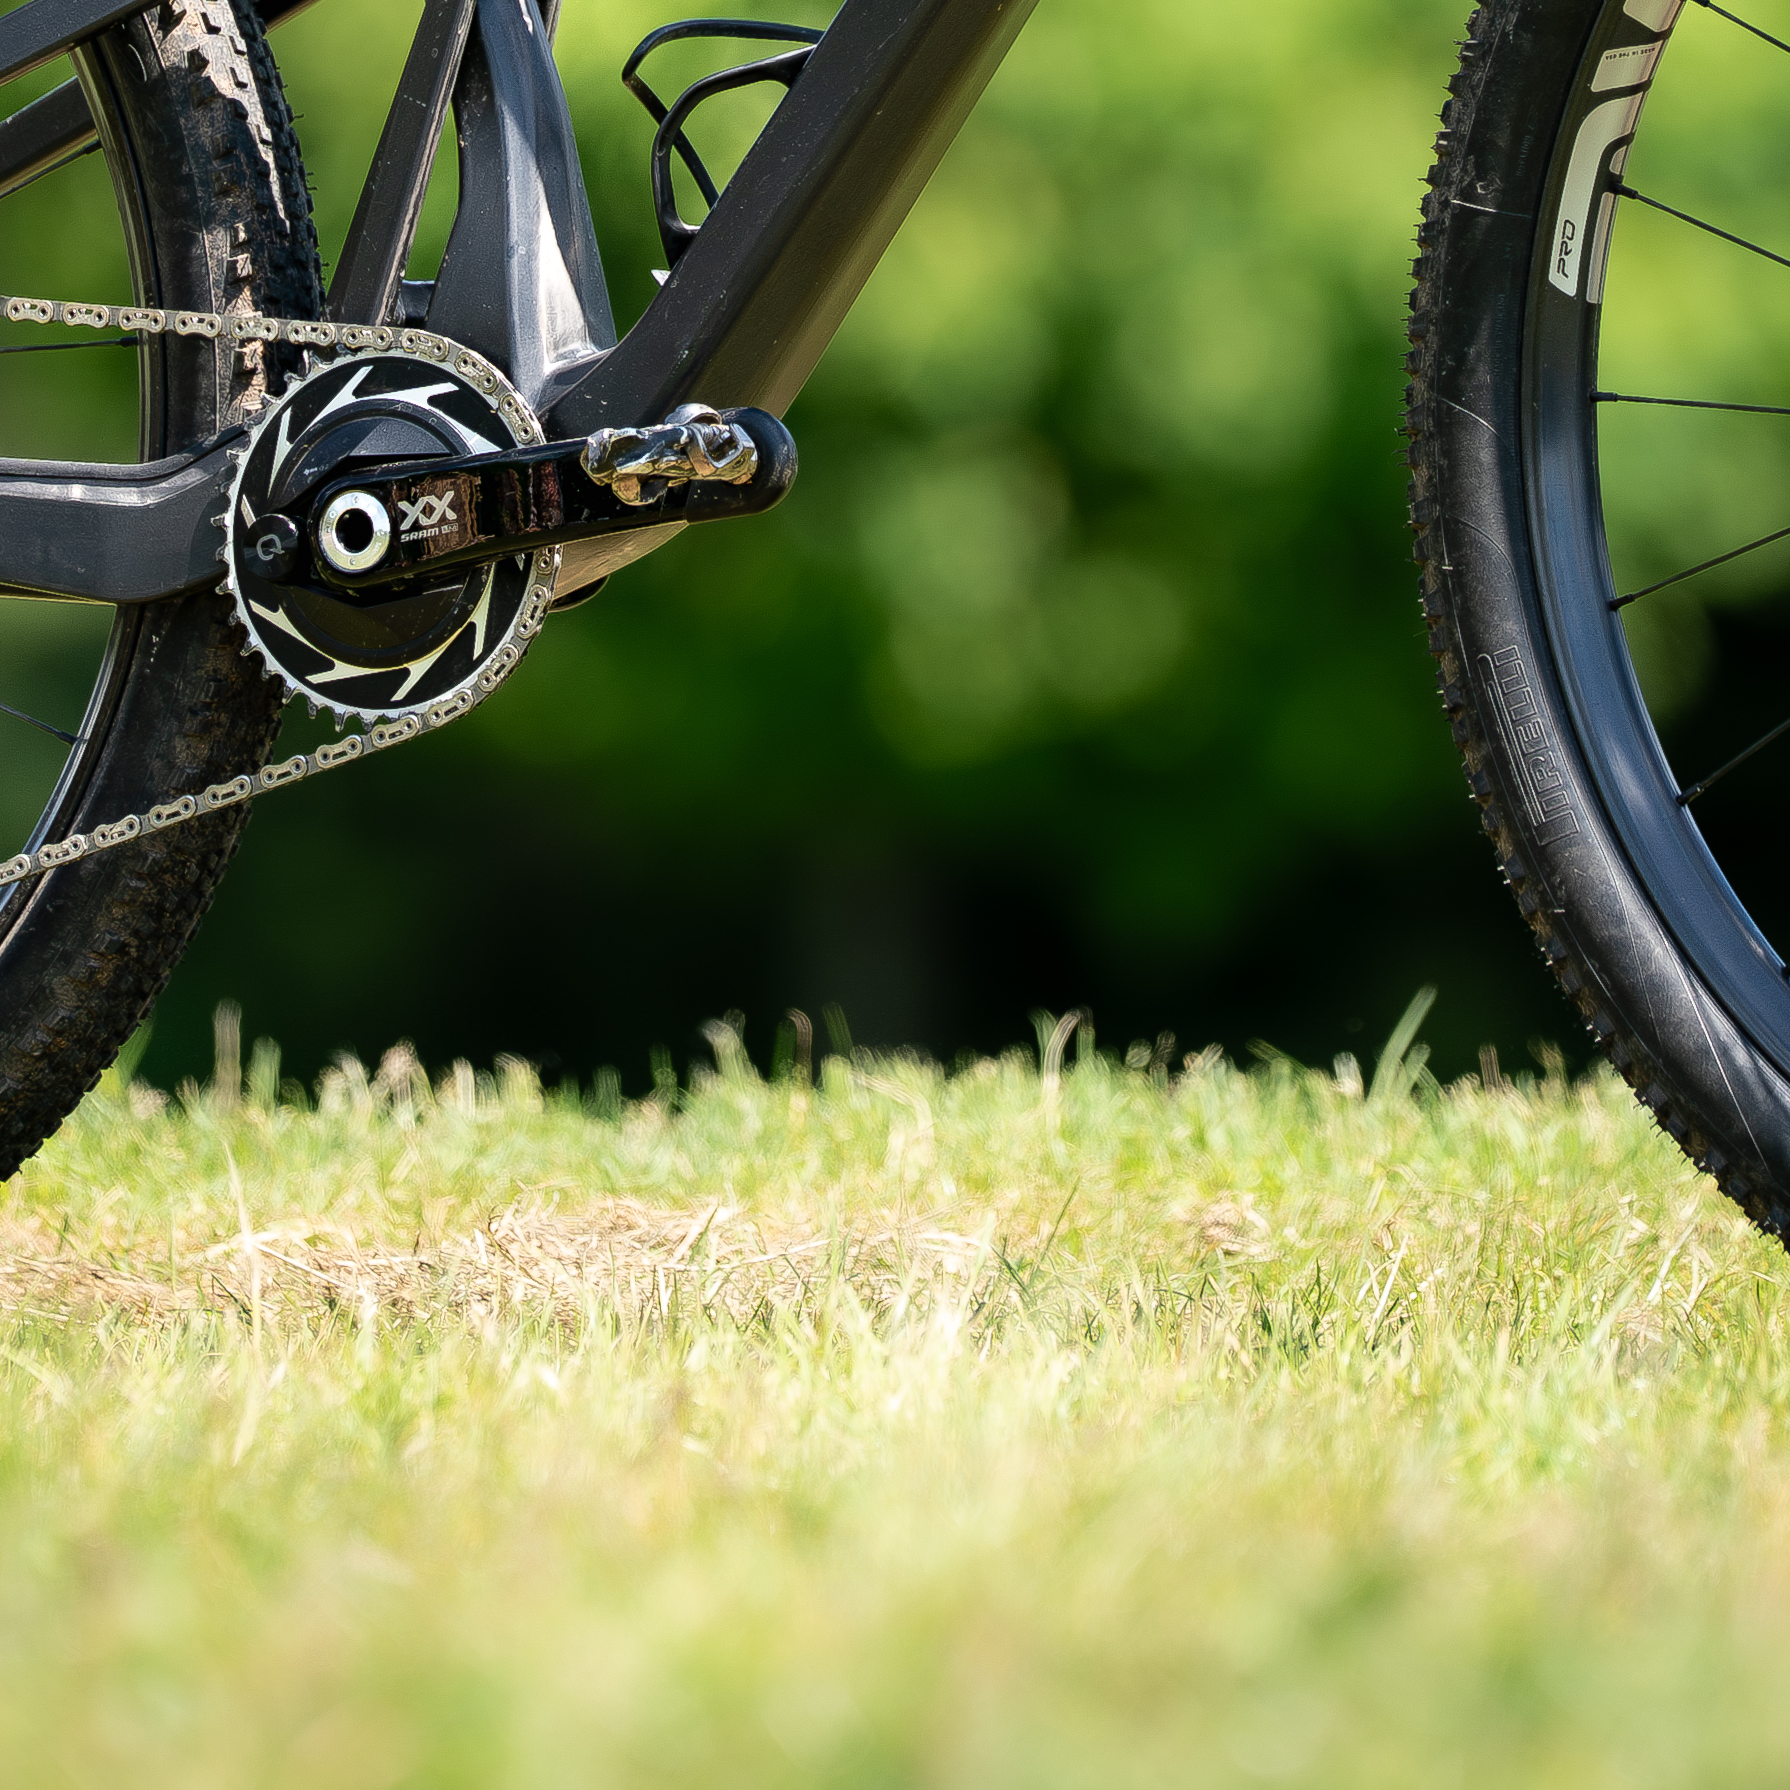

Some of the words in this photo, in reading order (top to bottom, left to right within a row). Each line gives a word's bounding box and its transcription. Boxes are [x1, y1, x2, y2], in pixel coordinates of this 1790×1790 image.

[1555, 218, 1577, 279] PRO
[397, 490, 458, 531] XX
[399, 527, 439, 543] SRAM
